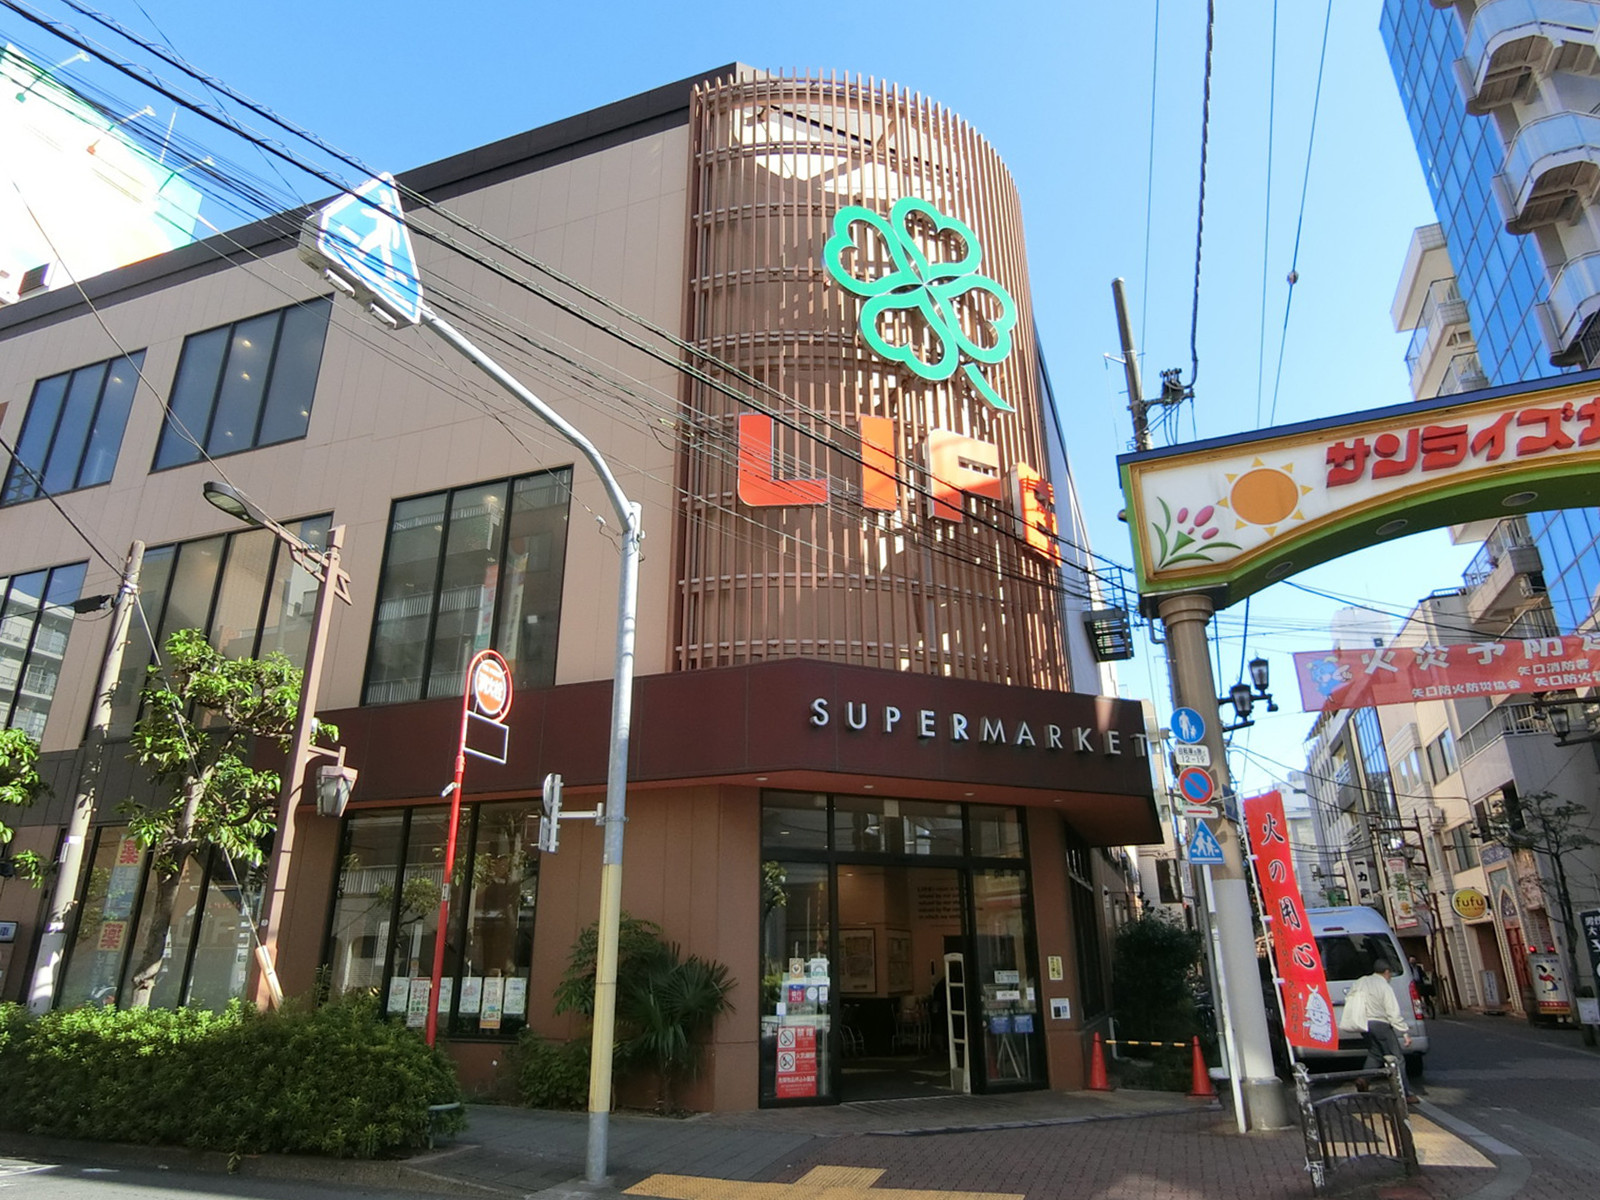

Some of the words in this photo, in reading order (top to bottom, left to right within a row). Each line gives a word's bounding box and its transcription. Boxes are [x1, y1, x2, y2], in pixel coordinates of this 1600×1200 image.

[738, 412, 1061, 566] LIFE
[809, 697, 1147, 757] SUPERMARKET
[1261, 813, 1316, 970] 火の用心
[1456, 895, 1484, 908] fufu
